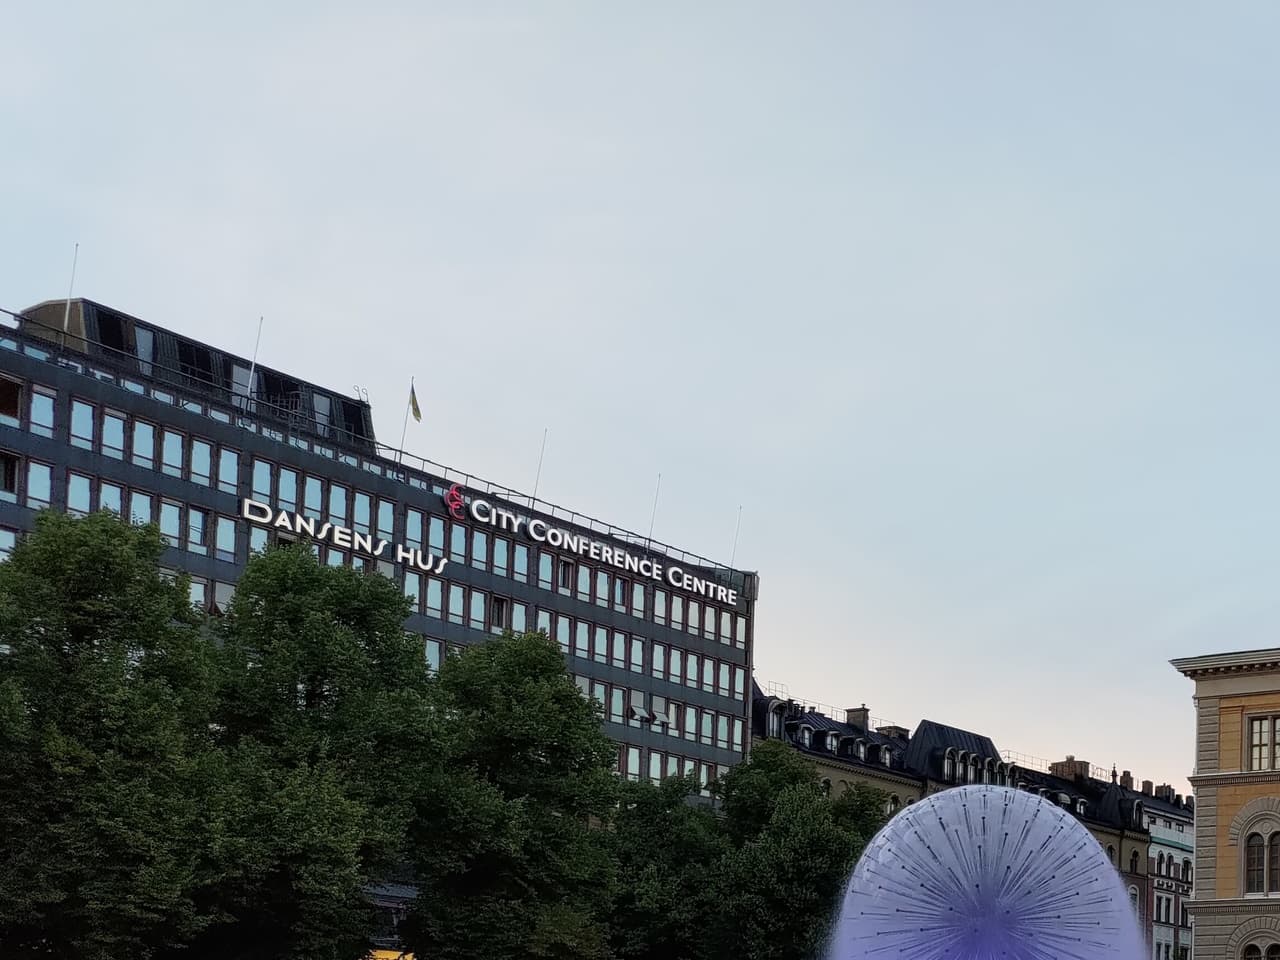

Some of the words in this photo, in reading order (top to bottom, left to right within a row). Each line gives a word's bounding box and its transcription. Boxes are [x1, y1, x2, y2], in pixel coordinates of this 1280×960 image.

[243, 498, 389, 556] DANSENS
[397, 543, 449, 574] HUS
[470, 499, 521, 533] CITY
[527, 518, 663, 582] CONFERENCE
[667, 566, 738, 606] CENTRE
